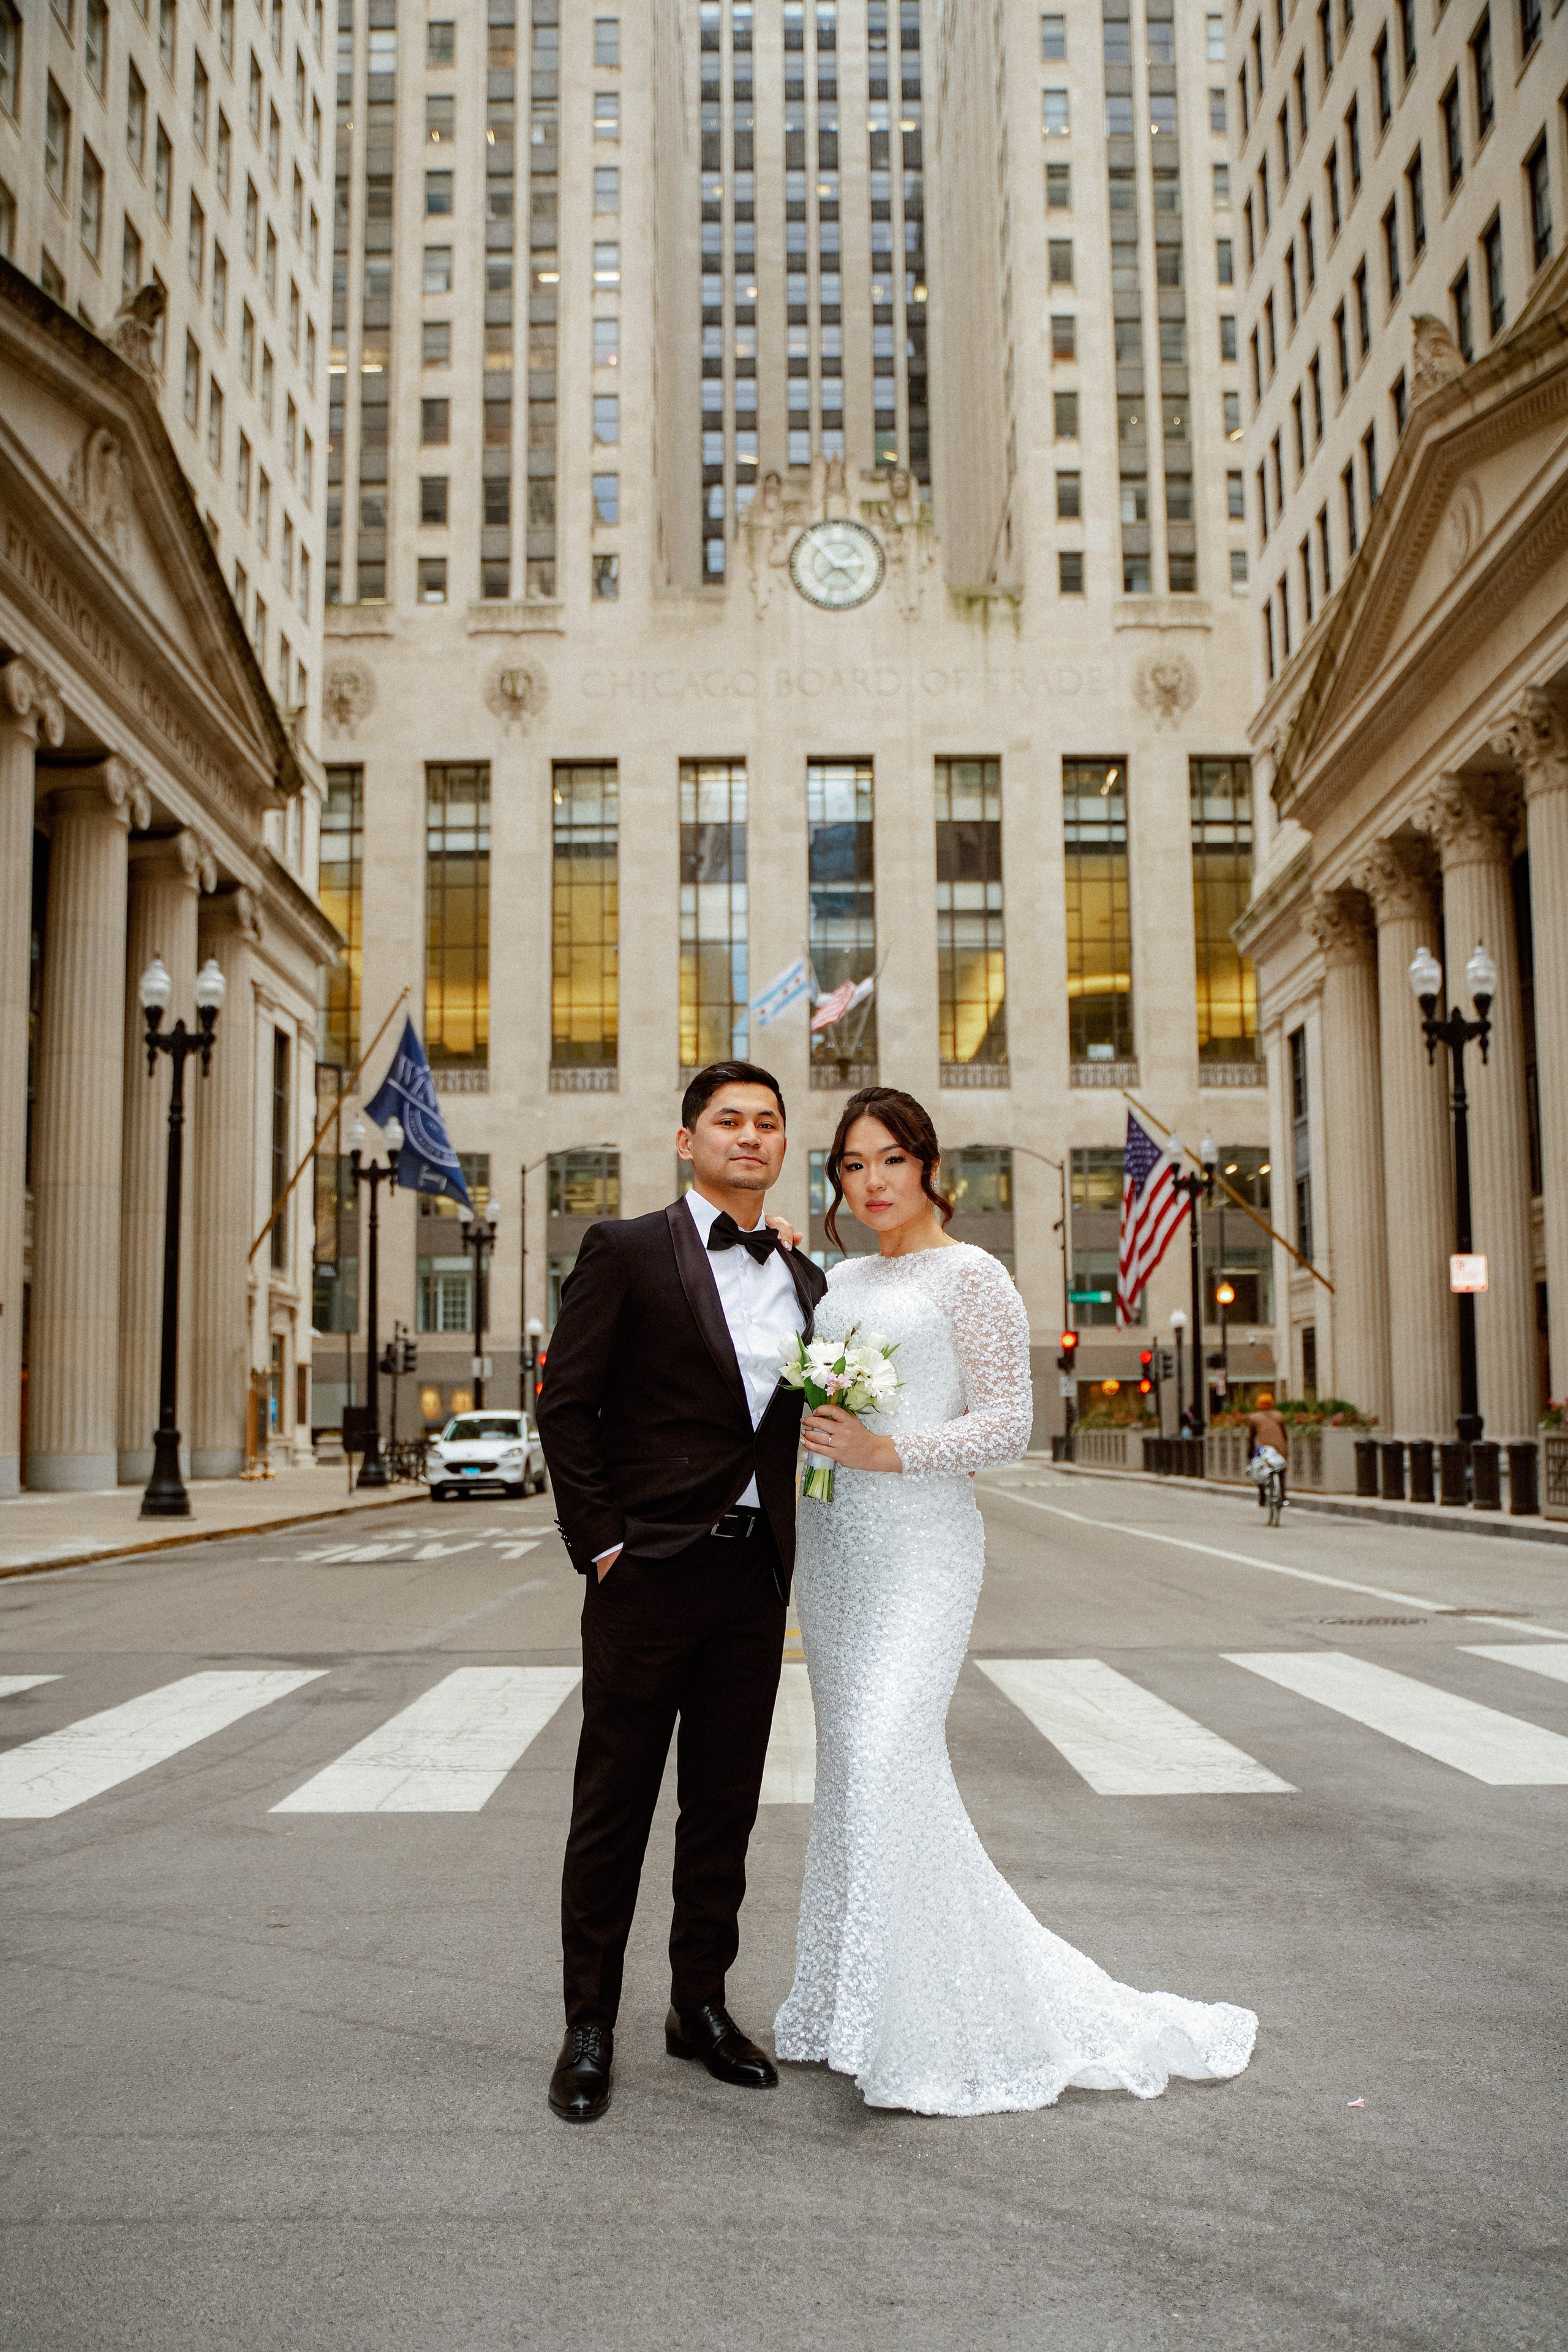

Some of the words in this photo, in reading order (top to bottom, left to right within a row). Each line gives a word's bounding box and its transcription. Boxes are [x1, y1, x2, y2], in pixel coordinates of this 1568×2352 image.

[4, 520, 126, 691] FINANCIAL
[580, 668, 759, 699] CHICAGO
[776, 666, 901, 698] BOARD
[920, 666, 969, 697] OF
[984, 666, 1108, 696] TRADE
